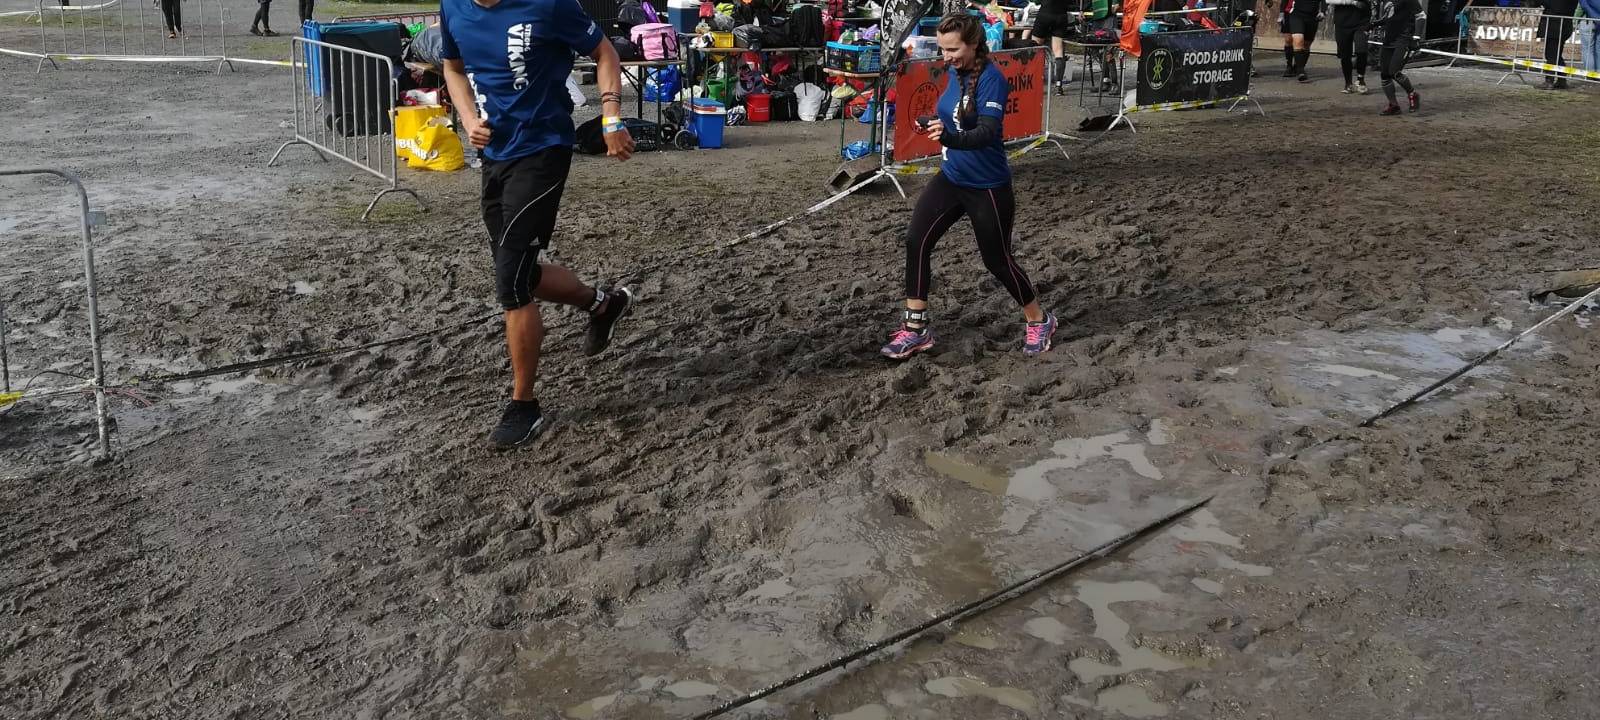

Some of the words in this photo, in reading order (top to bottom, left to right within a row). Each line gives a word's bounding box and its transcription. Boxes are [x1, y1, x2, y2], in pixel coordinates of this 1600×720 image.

[507, 23, 530, 91] VIKING
[1182, 51, 1211, 66] FOOD
[1211, 50, 1219, 64] &
[1219, 48, 1245, 63] DRINK
[1192, 68, 1234, 84] STORAGE
